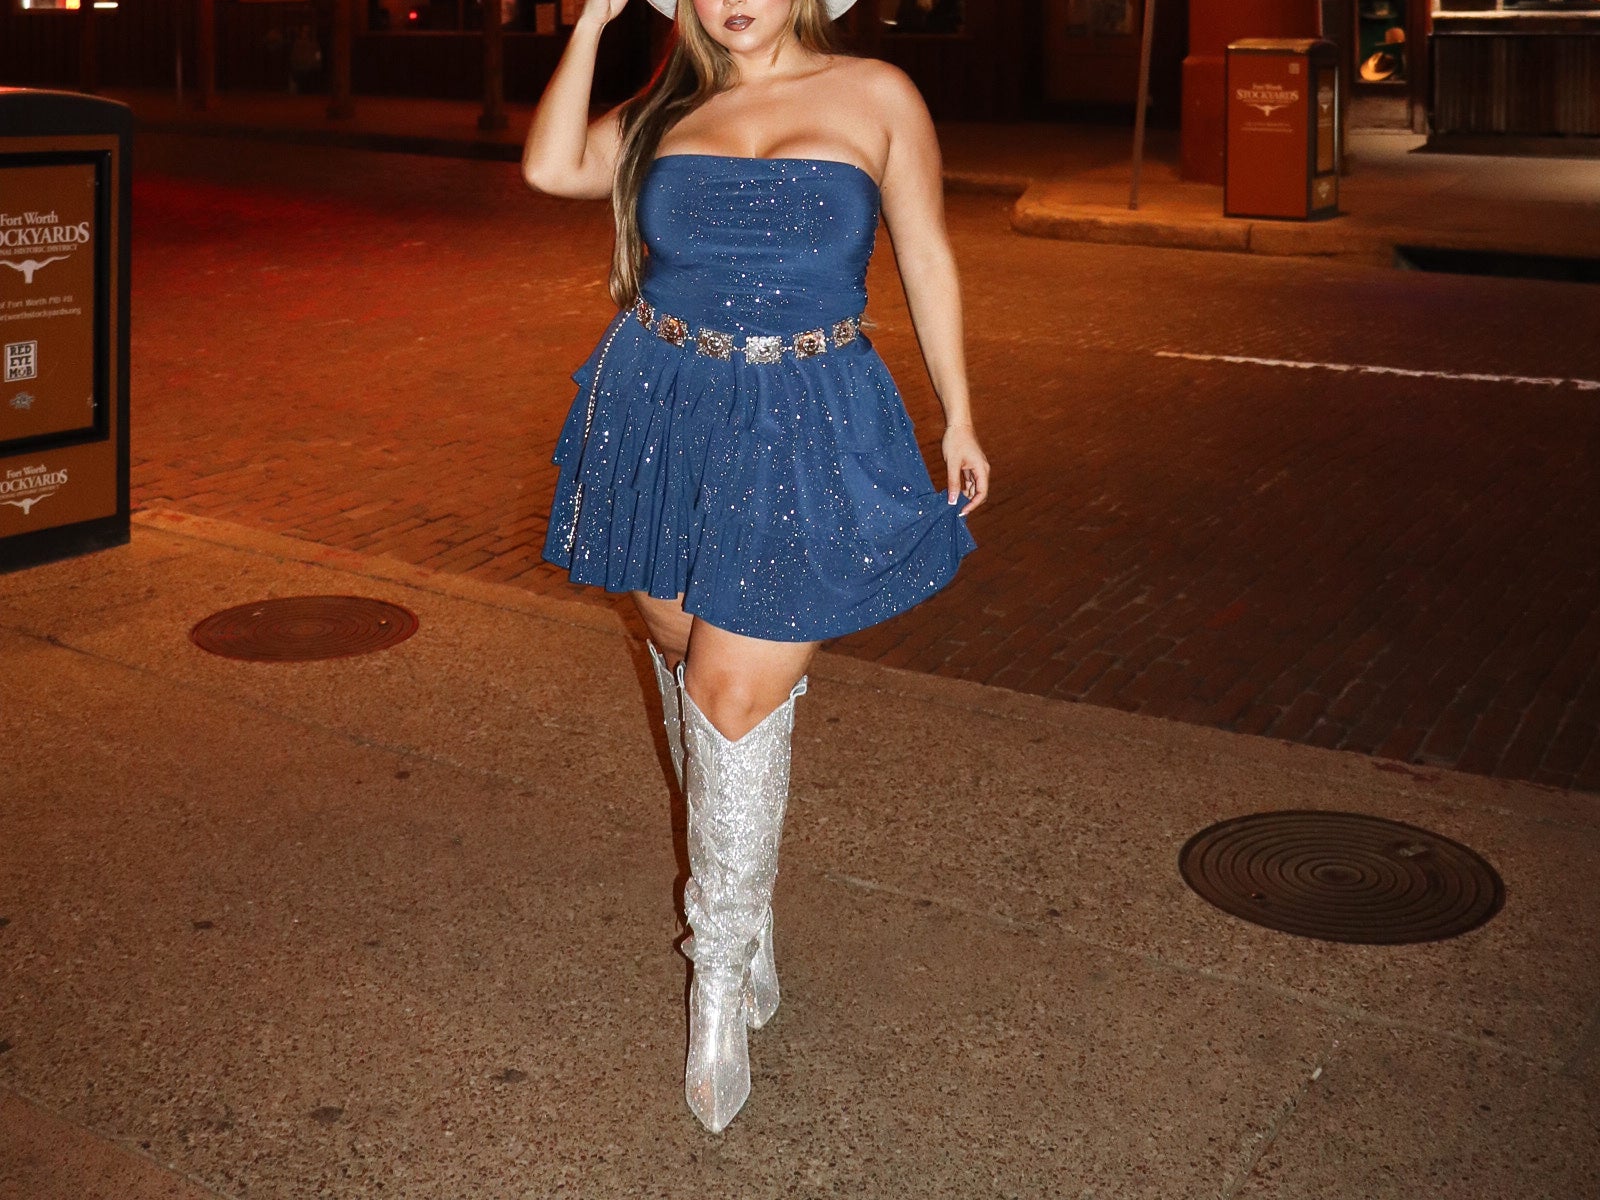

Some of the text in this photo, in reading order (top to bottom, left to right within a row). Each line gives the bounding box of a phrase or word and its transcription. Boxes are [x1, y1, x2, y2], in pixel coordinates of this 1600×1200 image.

[0, 210, 59, 226] Fort Worth
[9, 345, 32, 356] RED
[10, 356, 32, 367] EYE
[9, 366, 33, 378] MOB
[0, 469, 68, 493] OCKYARDS
